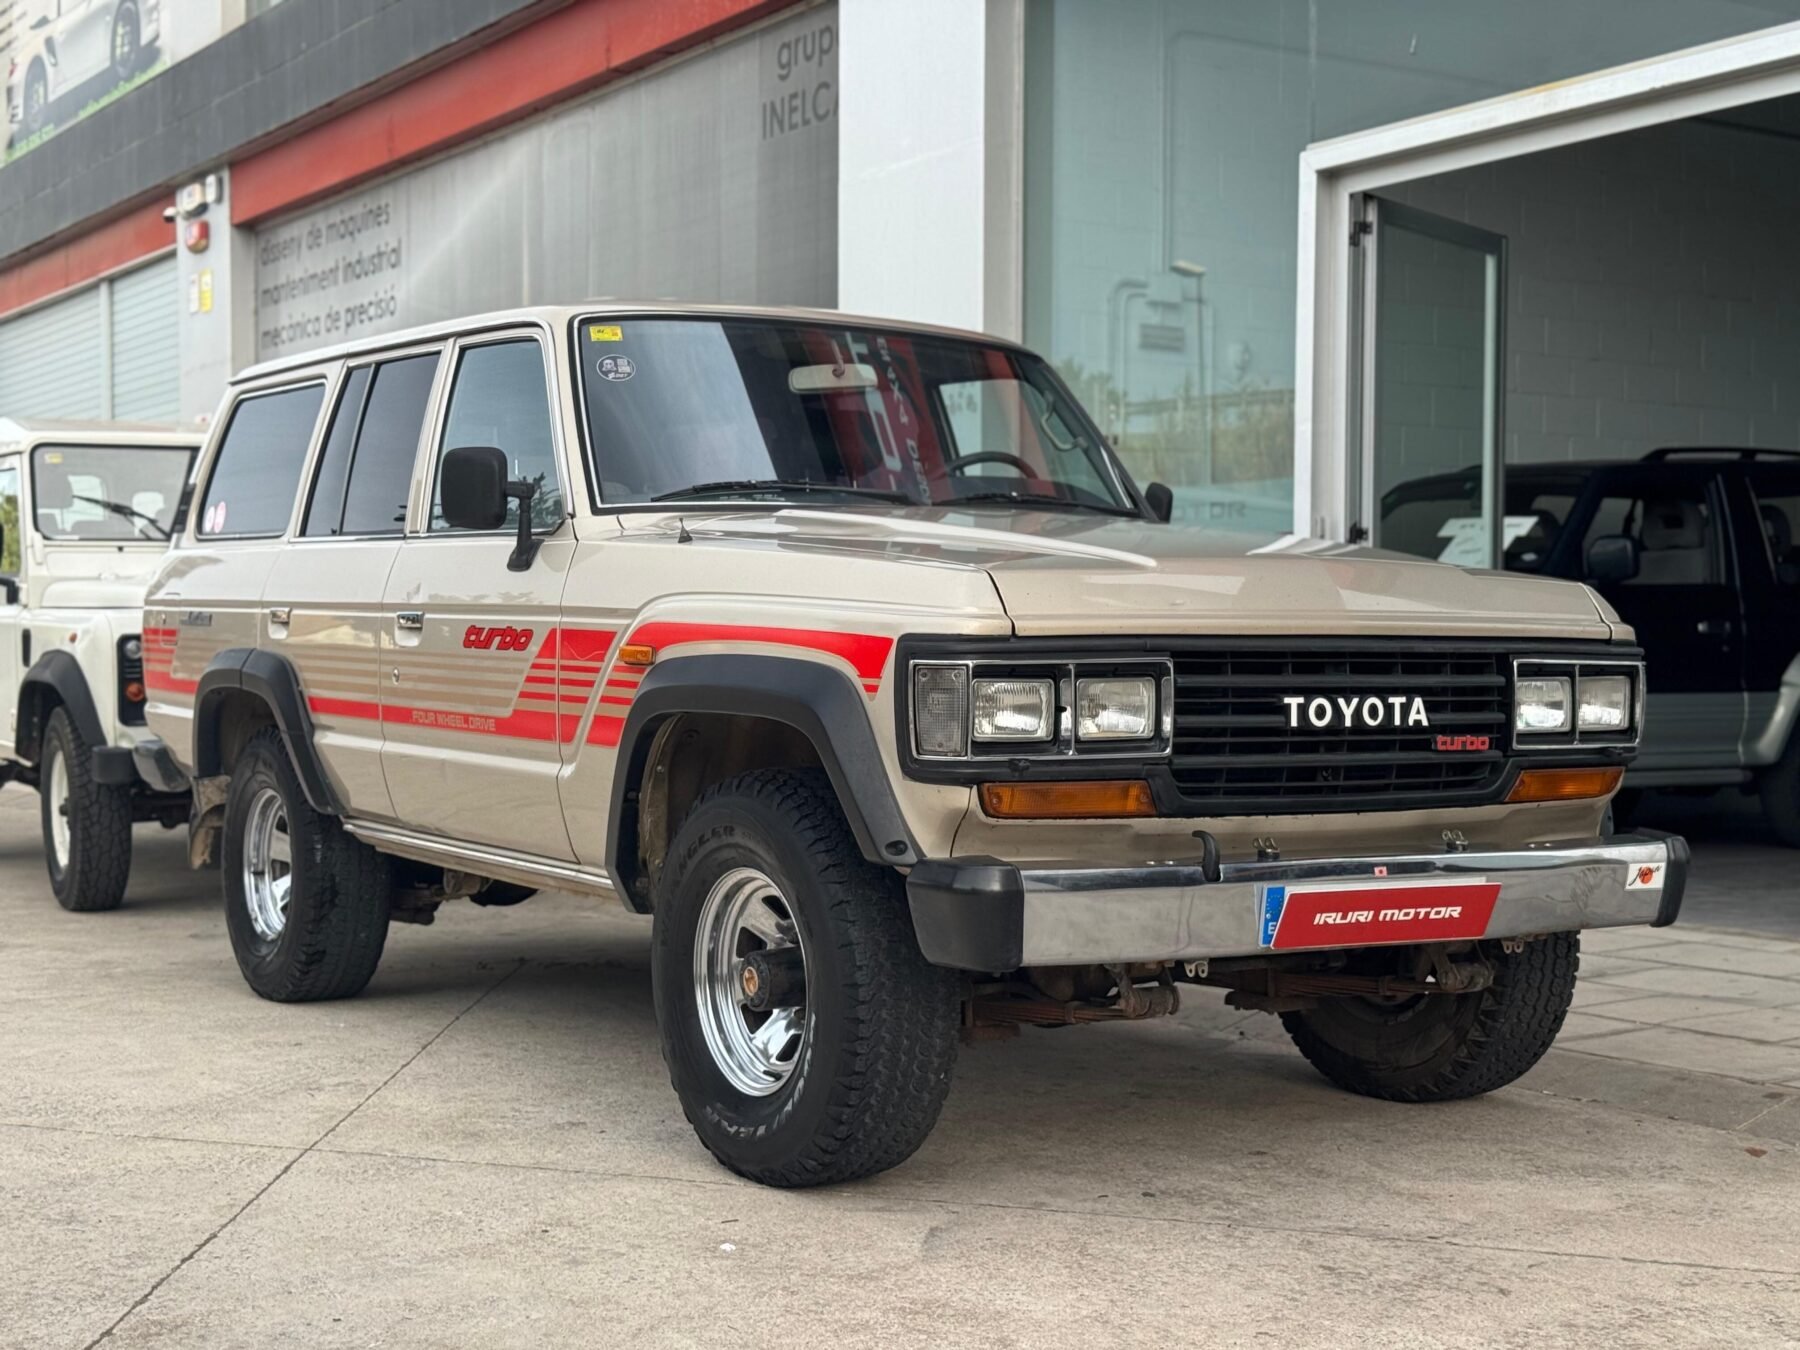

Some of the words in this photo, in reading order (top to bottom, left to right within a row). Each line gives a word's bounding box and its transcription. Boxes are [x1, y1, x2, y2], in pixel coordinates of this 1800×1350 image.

[777, 25, 838, 82] grup
[306, 222, 323, 250] de
[261, 259, 339, 307] manteniment
[343, 238, 402, 283] industrial
[324, 305, 341, 333] de
[345, 284, 396, 334] precisió
[463, 625, 534, 651] turbo
[411, 710, 436, 726] FOUR
[437, 712, 468, 729] WHEEL
[468, 715, 497, 732] DRIVE
[1284, 696, 1429, 727] TOYOTA
[1436, 735, 1490, 751] turbo
[1267, 921, 1277, 935] E
[1313, 910, 1374, 925] IRURI
[1379, 906, 1462, 922] MOTOR
